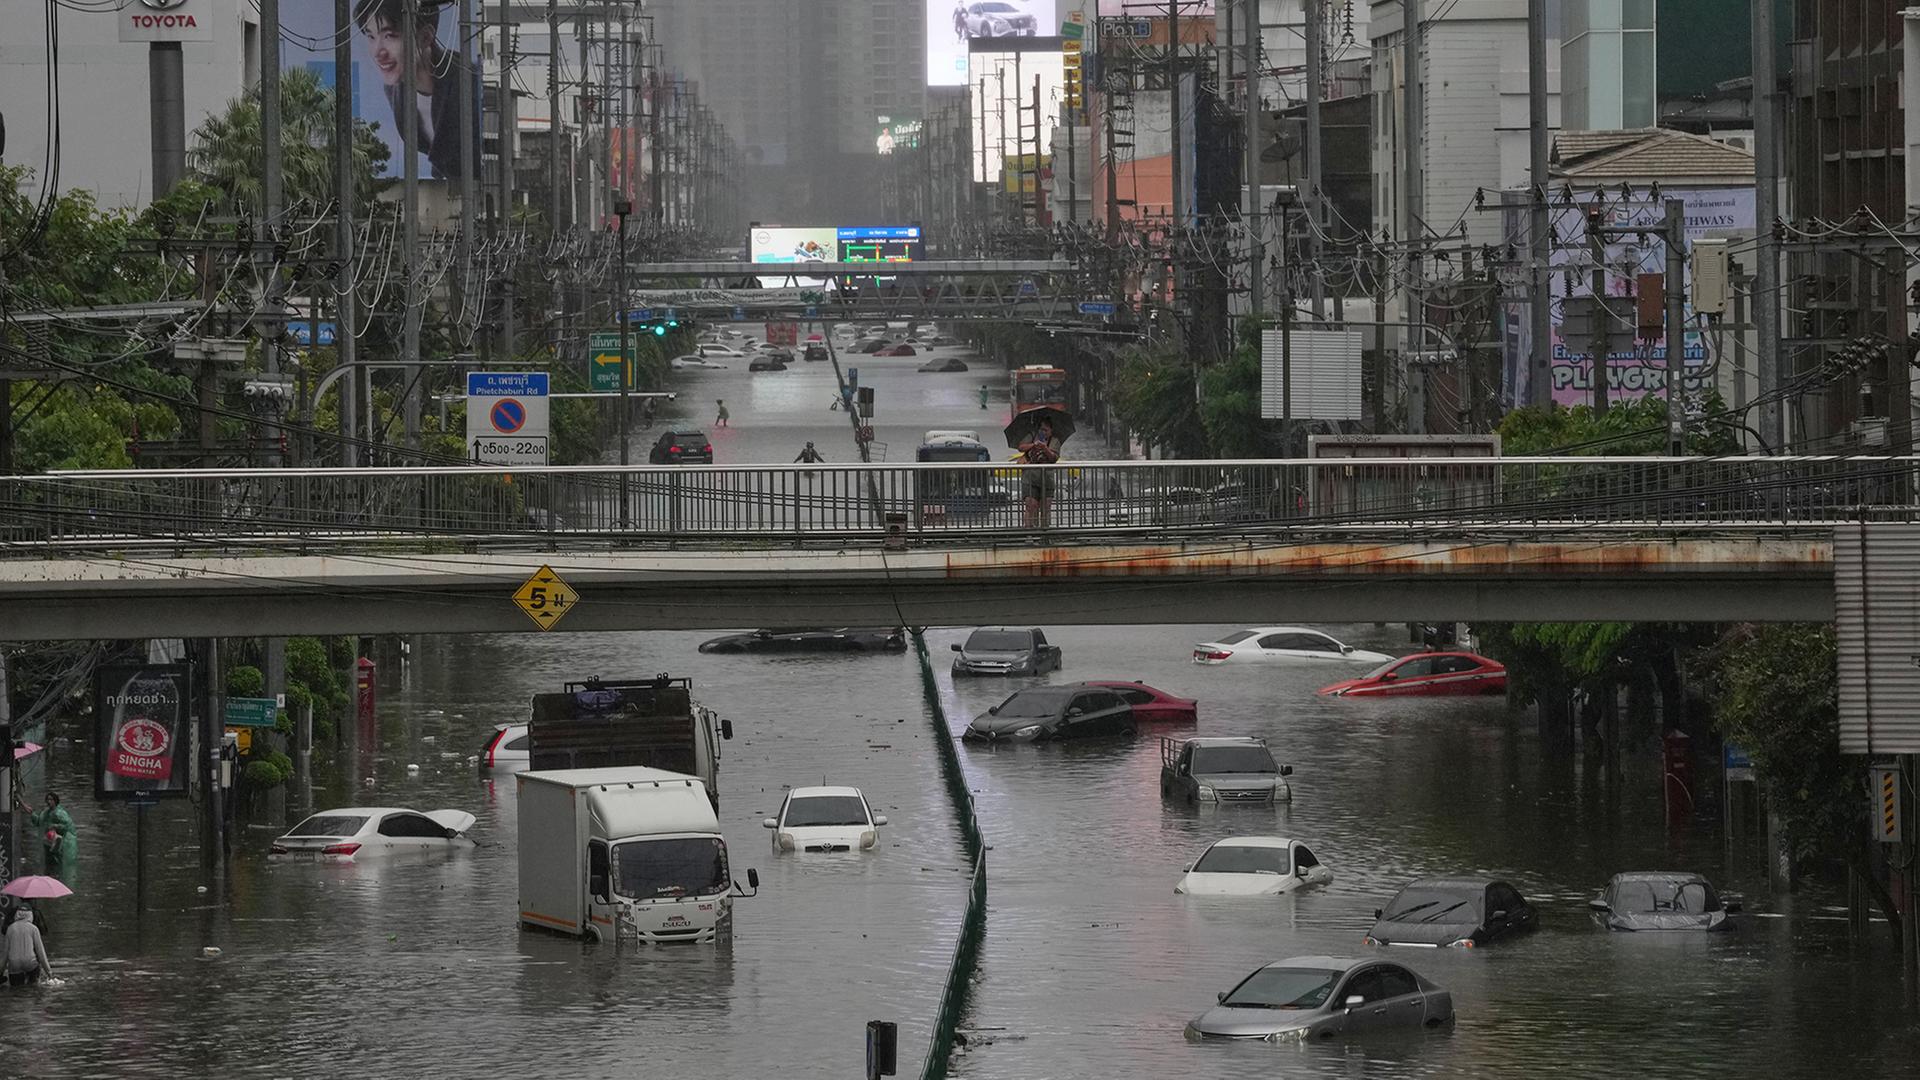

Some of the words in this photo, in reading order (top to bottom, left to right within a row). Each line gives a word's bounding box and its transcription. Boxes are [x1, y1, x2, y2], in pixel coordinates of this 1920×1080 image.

[131, 15, 197, 28] TOYOTA
[499, 374, 529, 388] เพชรบุรี
[476, 387, 525, 395] Phetchaburi
[527, 387, 538, 395] Rd
[530, 587, 546, 609] 5
[119, 755, 162, 769] SINGHA
[662, 920, 691, 928] ISUZU
